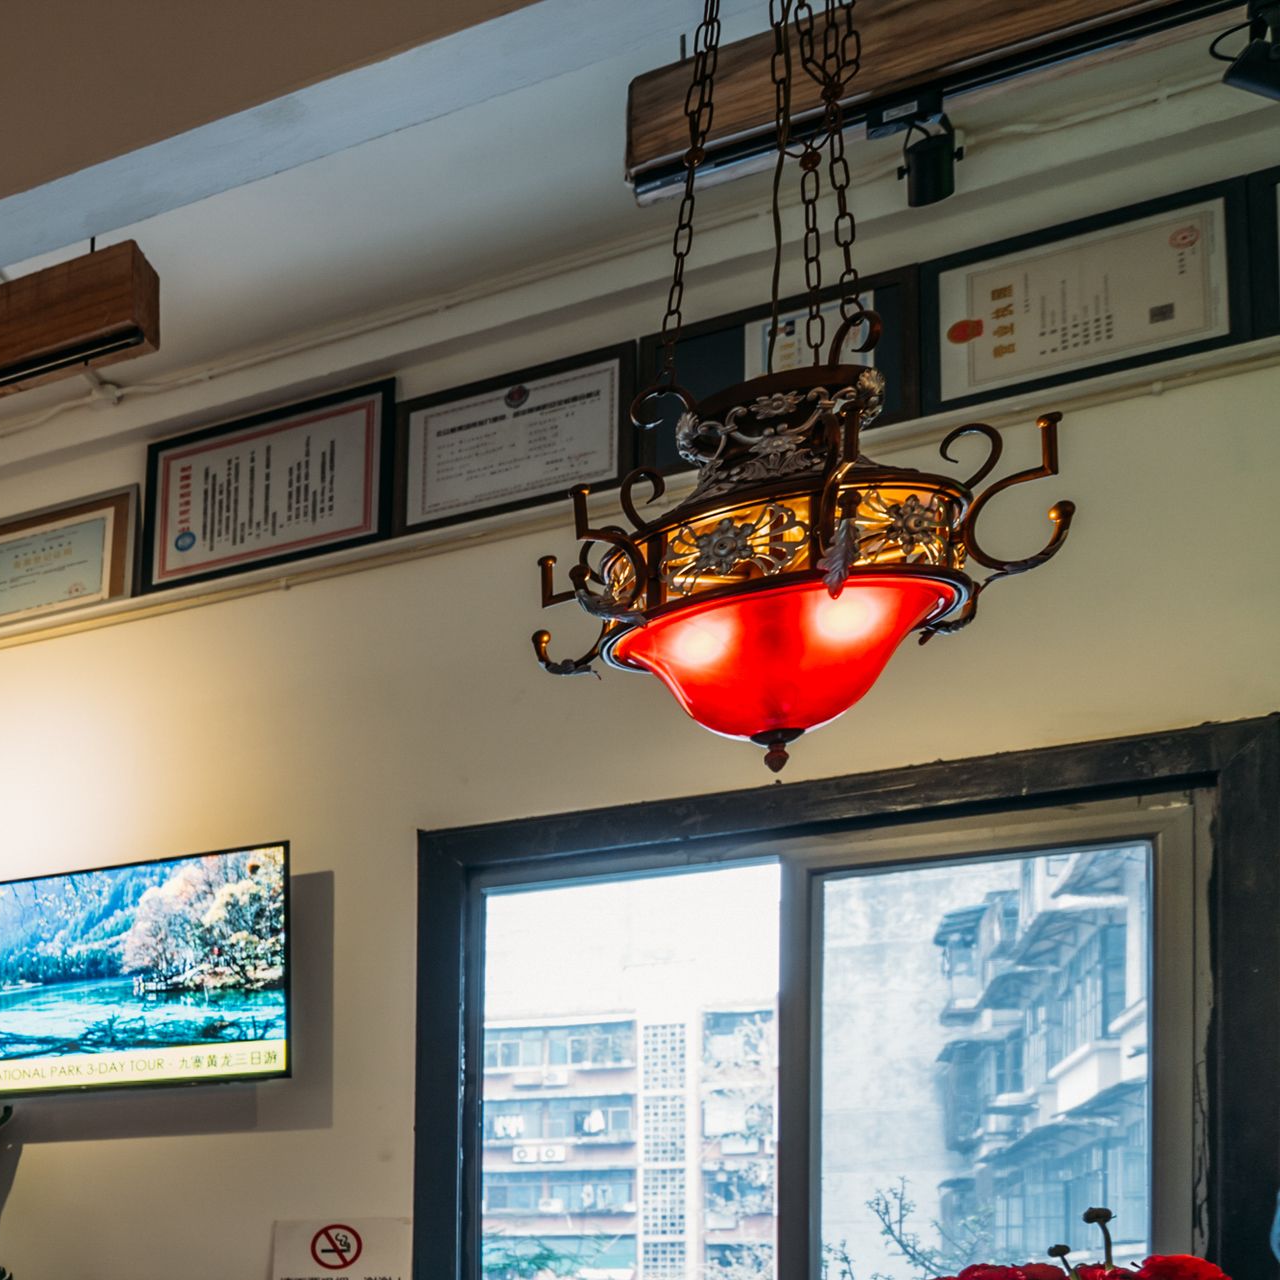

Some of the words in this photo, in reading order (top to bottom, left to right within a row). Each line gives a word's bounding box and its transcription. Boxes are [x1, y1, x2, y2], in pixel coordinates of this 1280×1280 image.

[50, 1064, 82, 1079] PARK
[87, 1060, 126, 1076] 3-DAY
[130, 1057, 165, 1073] TOUR
[178, 1050, 278, 1071] 九寨黄龙三日游
